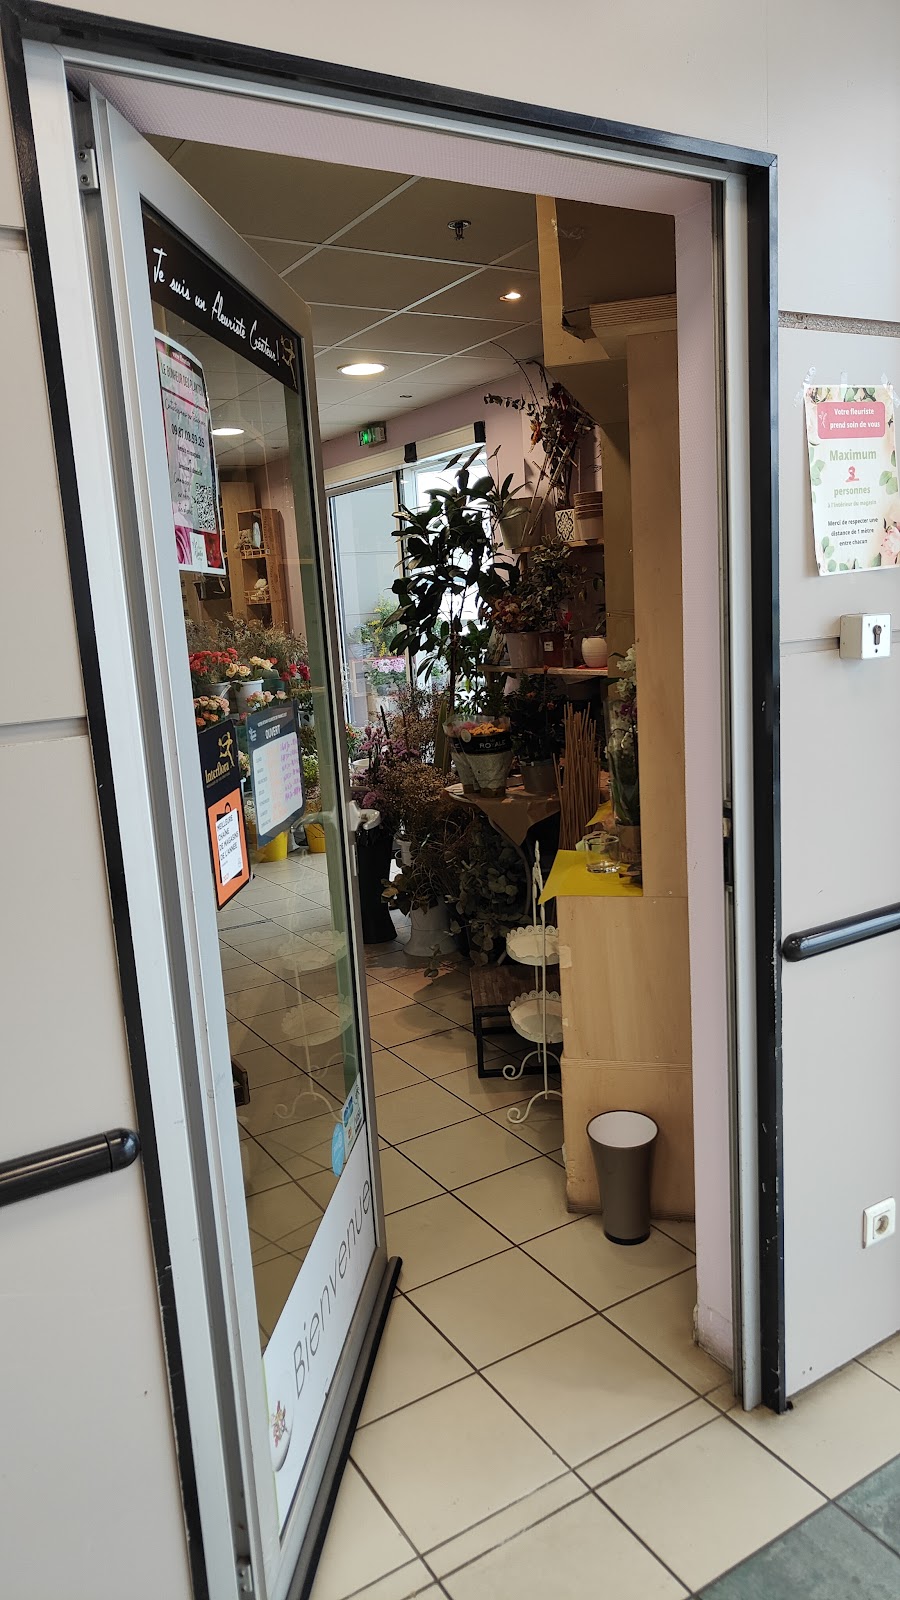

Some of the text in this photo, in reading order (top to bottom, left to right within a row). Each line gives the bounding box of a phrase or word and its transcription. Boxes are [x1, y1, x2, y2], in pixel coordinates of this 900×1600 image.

[152, 247, 168, 283] Je
[169, 278, 191, 301] suis
[194, 295, 207, 312] un
[834, 407, 875, 416] Votre fleuriste
[829, 421, 846, 431] prend
[846, 420, 859, 429] soin
[859, 420, 867, 428] de
[829, 448, 877, 461] Maximum
[834, 486, 871, 499] personnes
[848, 518, 869, 526] respecter
[265, 724, 280, 740] OUVERT
[204, 761, 230, 784] Interflora
[219, 830, 239, 852] DE MAGASINS
[293, 1179, 370, 1400] Bienvenue
